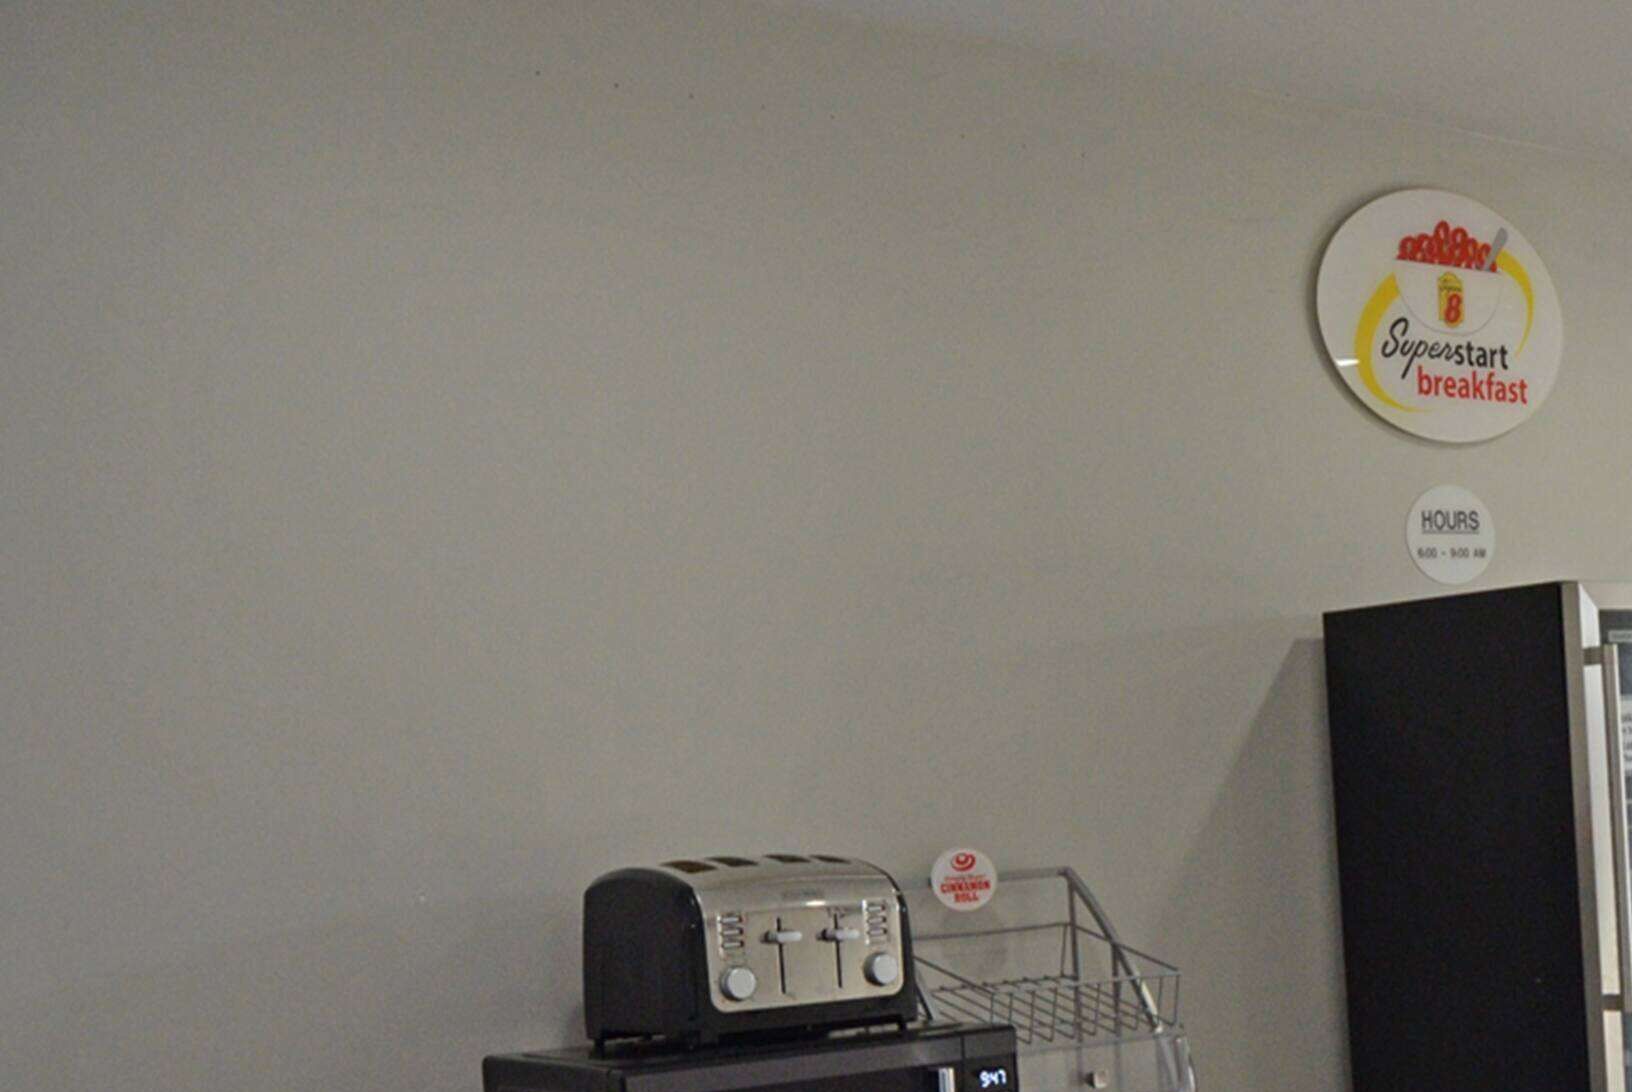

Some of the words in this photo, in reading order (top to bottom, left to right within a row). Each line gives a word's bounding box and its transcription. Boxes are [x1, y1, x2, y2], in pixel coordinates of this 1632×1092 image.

[1444, 293, 1462, 324] 8
[1381, 317, 1508, 380] Superstart
[1416, 364, 1528, 405] breakfast
[1420, 509, 1480, 531] HOURS
